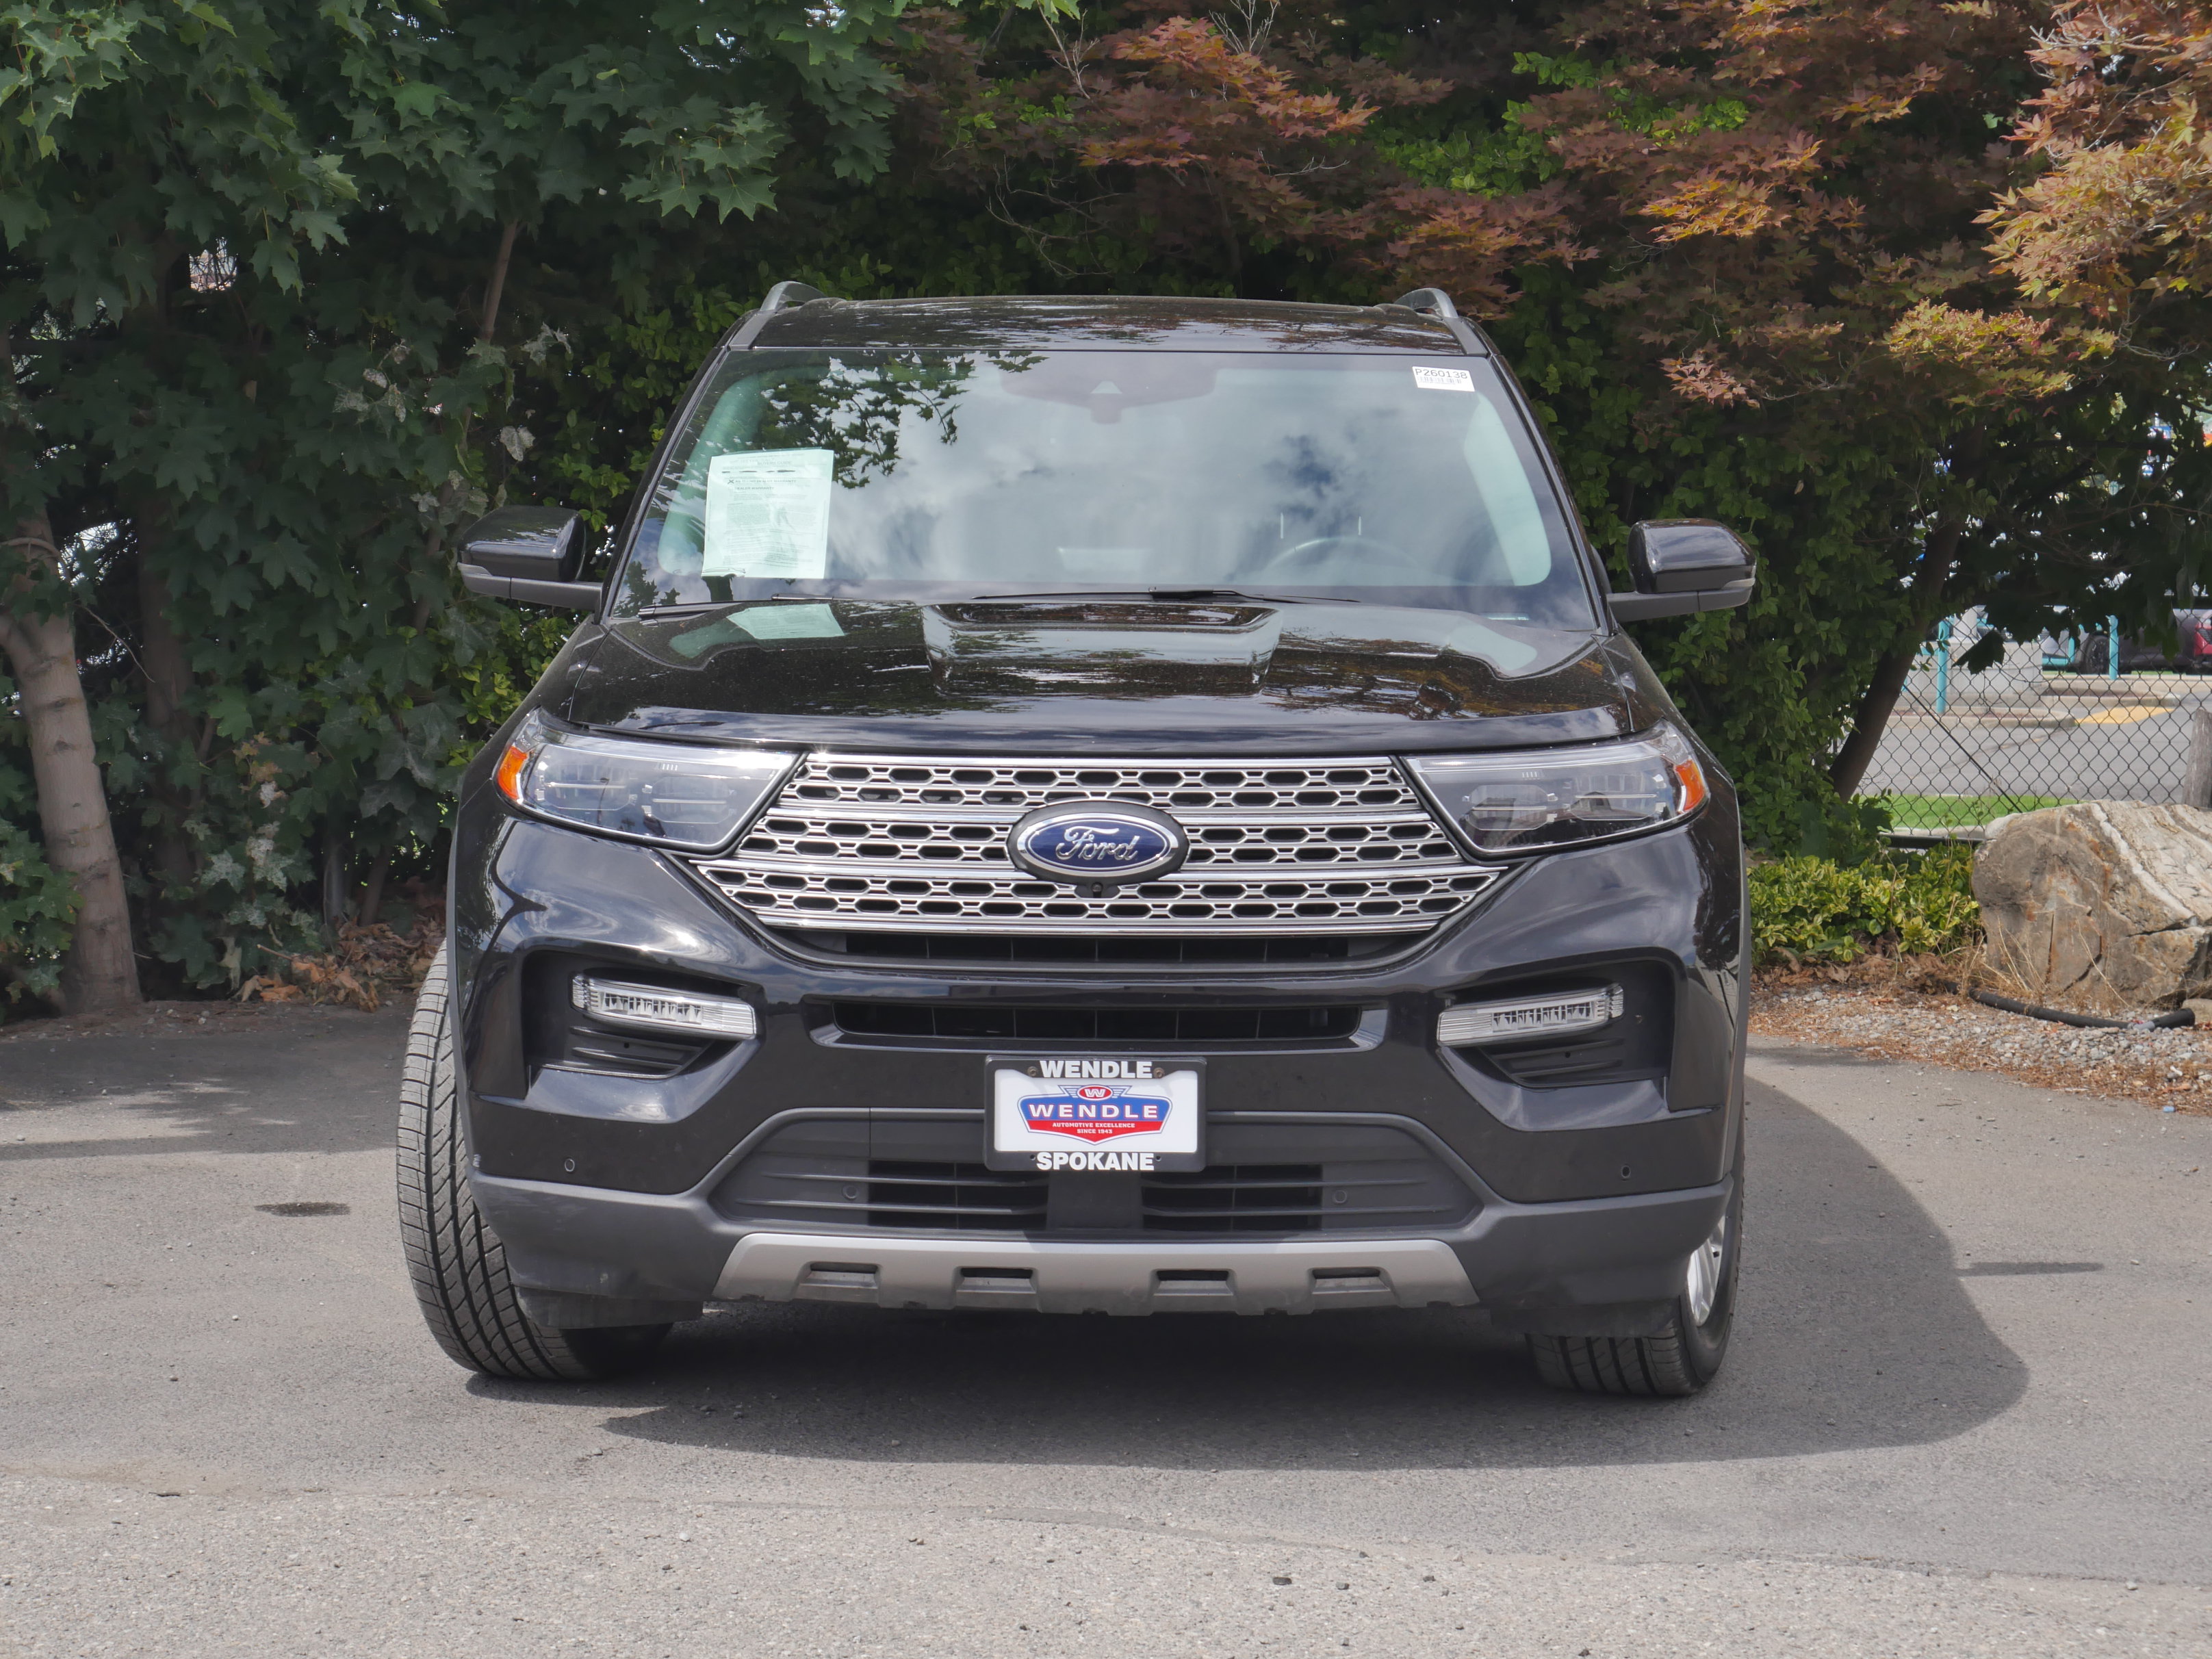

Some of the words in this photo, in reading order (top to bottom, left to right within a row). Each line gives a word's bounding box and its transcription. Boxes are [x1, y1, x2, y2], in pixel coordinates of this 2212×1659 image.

[1415, 368, 1467, 379] P260138
[1055, 825, 1140, 860] Ford
[1040, 1060, 1153, 1078] WENDLE
[1029, 1104, 1158, 1118] WENDLE
[1036, 1152, 1155, 1171] SPOKANE
